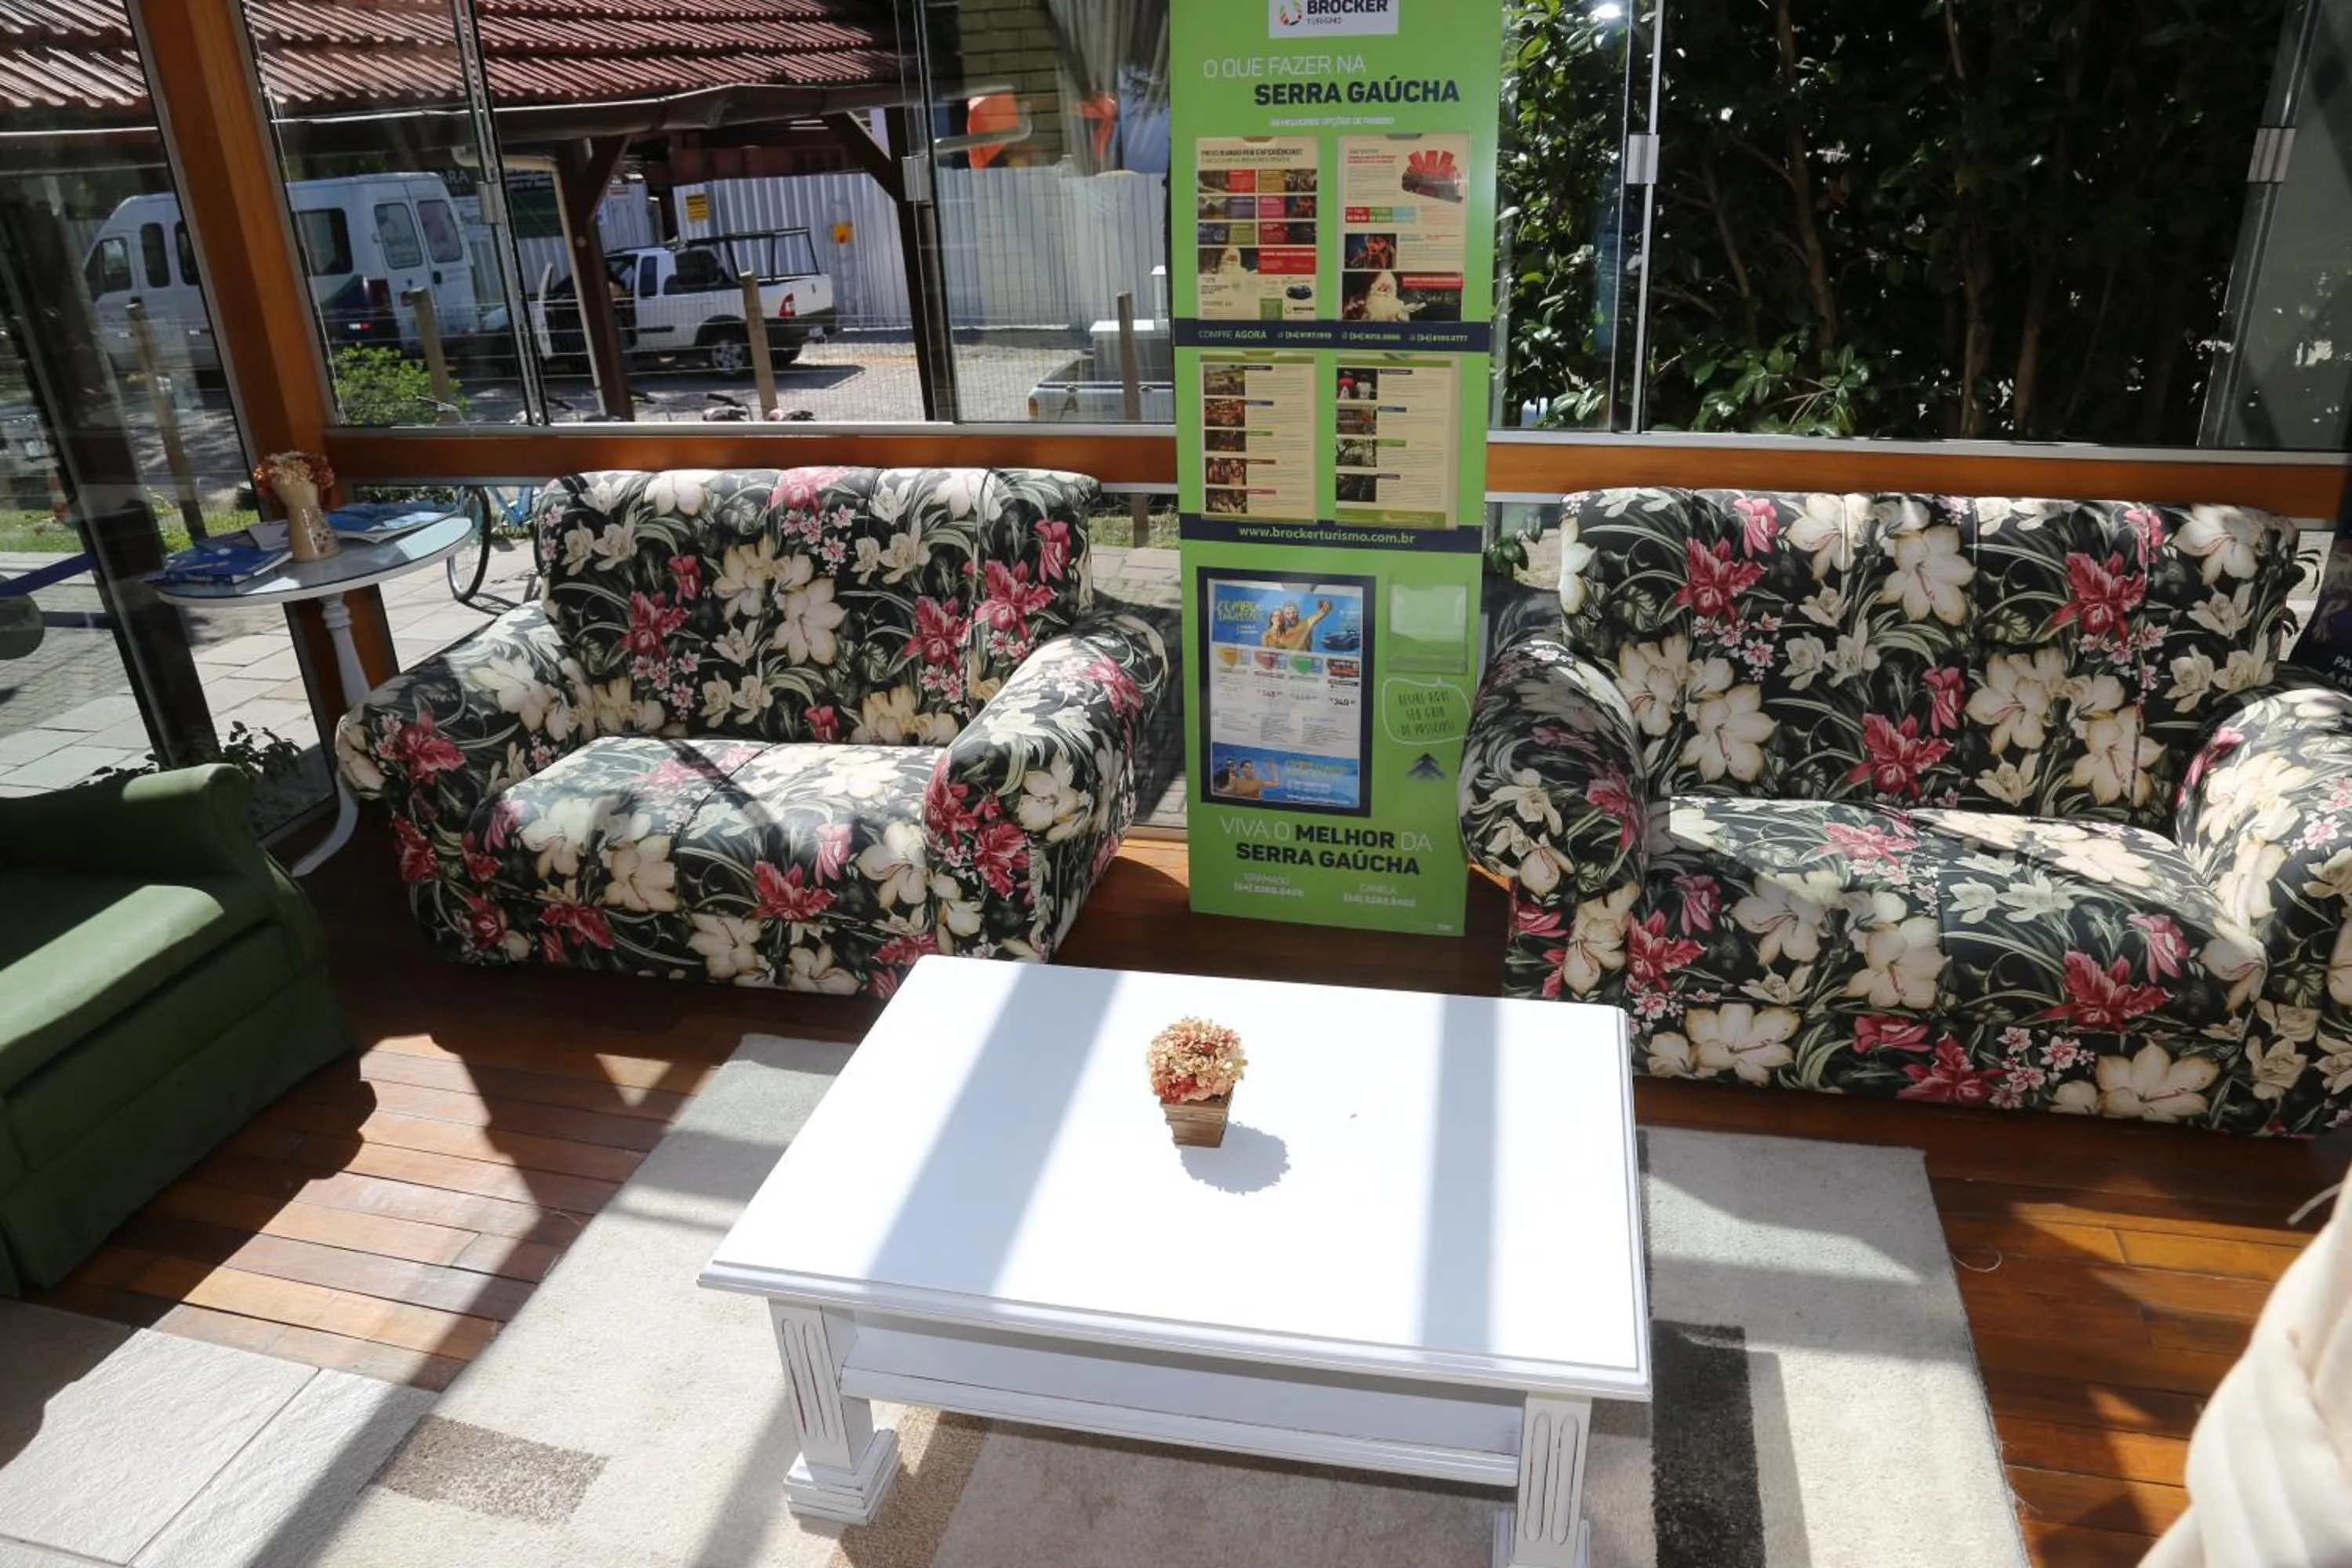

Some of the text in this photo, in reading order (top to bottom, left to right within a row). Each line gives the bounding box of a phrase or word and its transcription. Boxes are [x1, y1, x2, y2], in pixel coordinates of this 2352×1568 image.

[1306, 0, 1388, 14] BROCKER
[1203, 54, 1367, 78] O QUE FAZER NA
[1254, 74, 1460, 106] SERRA GAÚCHA
[1234, 329, 1268, 339] AGORA
[1239, 526, 1415, 545] www.brockerturismo.com.br
[1219, 815, 1433, 852] VIVA O MELHOR DA
[1236, 843, 1420, 876] SERRA GAÚCHA
